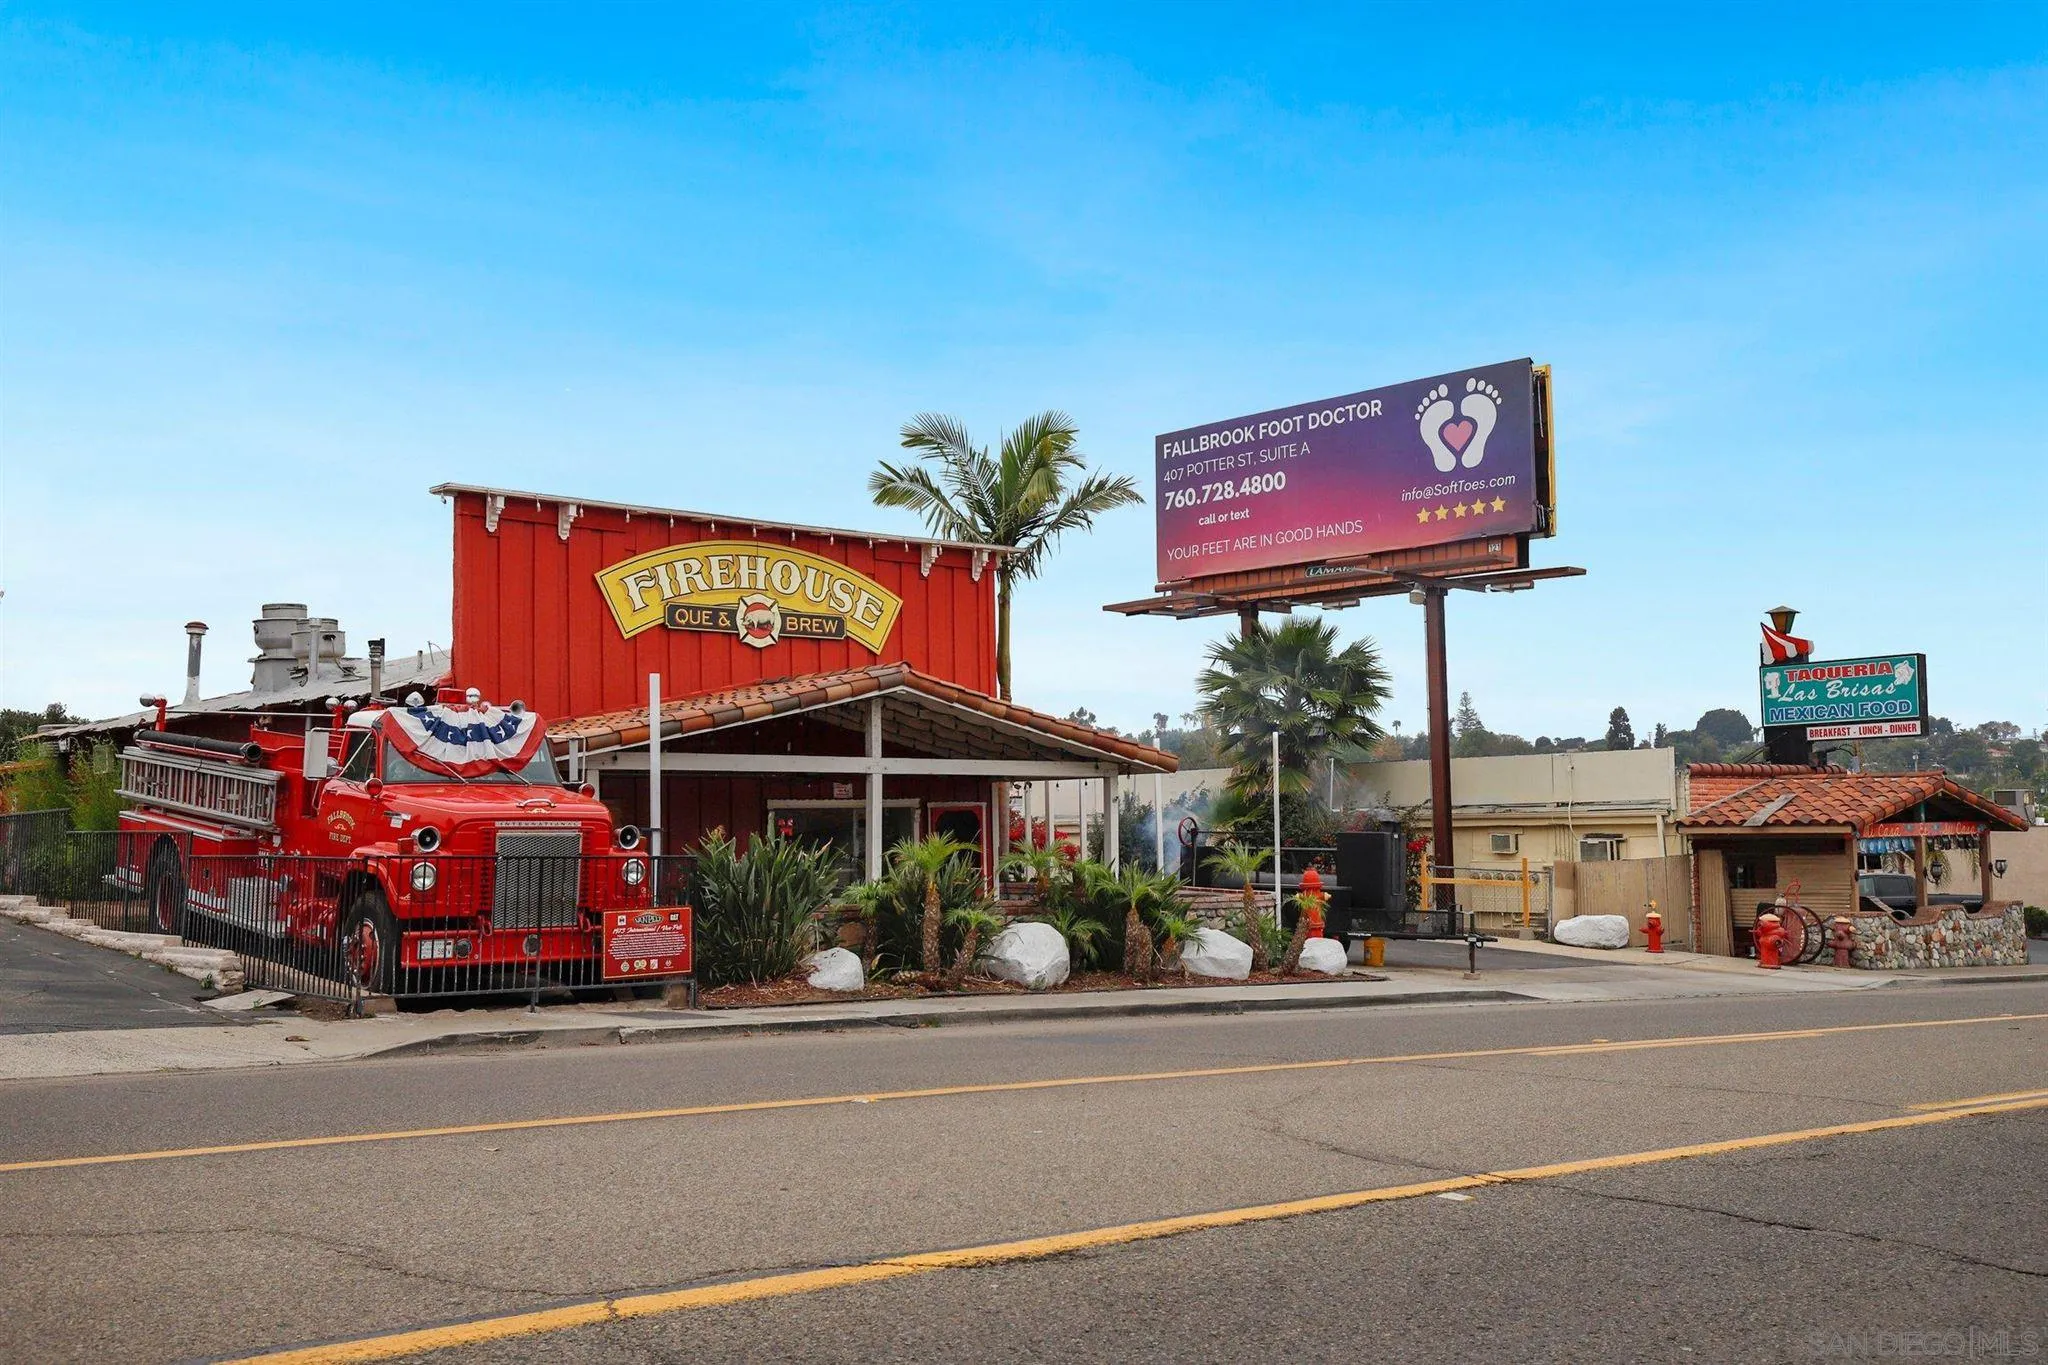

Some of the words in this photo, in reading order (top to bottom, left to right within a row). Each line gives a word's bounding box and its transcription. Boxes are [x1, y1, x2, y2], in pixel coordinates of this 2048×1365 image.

[1163, 425, 1255, 459] FALLBROOK
[1259, 415, 1303, 440] FOOT
[1308, 399, 1382, 430] DOCTOR
[1163, 467, 1184, 483] 407
[1187, 455, 1234, 477] POTTER
[1259, 444, 1297, 463] SUITE
[1300, 441, 1311, 456] A
[1164, 471, 1287, 510] 760.728.4800
[1401, 475, 1516, 502] info@SoftToes.com
[1198, 511, 1216, 526] call
[1218, 513, 1228, 523] or
[1230, 508, 1250, 520] text
[1167, 544, 1200, 560] YOUR
[1202, 539, 1231, 556] FEET
[1233, 535, 1257, 551] ARE
[1260, 534, 1273, 547] IN
[1275, 527, 1313, 545] GOOD
[1316, 519, 1363, 539] HANDS
[622, 554, 885, 630] FIREHOUSE
[675, 608, 714, 627] QUE
[719, 611, 731, 627] &
[786, 618, 839, 635] BREW
[1784, 661, 1893, 683] TAQUERIA
[1778, 683, 1818, 702] Las
[1826, 679, 1897, 700] Brisas
[1769, 703, 1853, 723] MEXICAN
[1859, 699, 1912, 717] FOOD
[1809, 726, 1851, 738] BREAKFAST
[1858, 724, 1883, 735] LUNCH
[1889, 723, 1917, 734] DINNER
